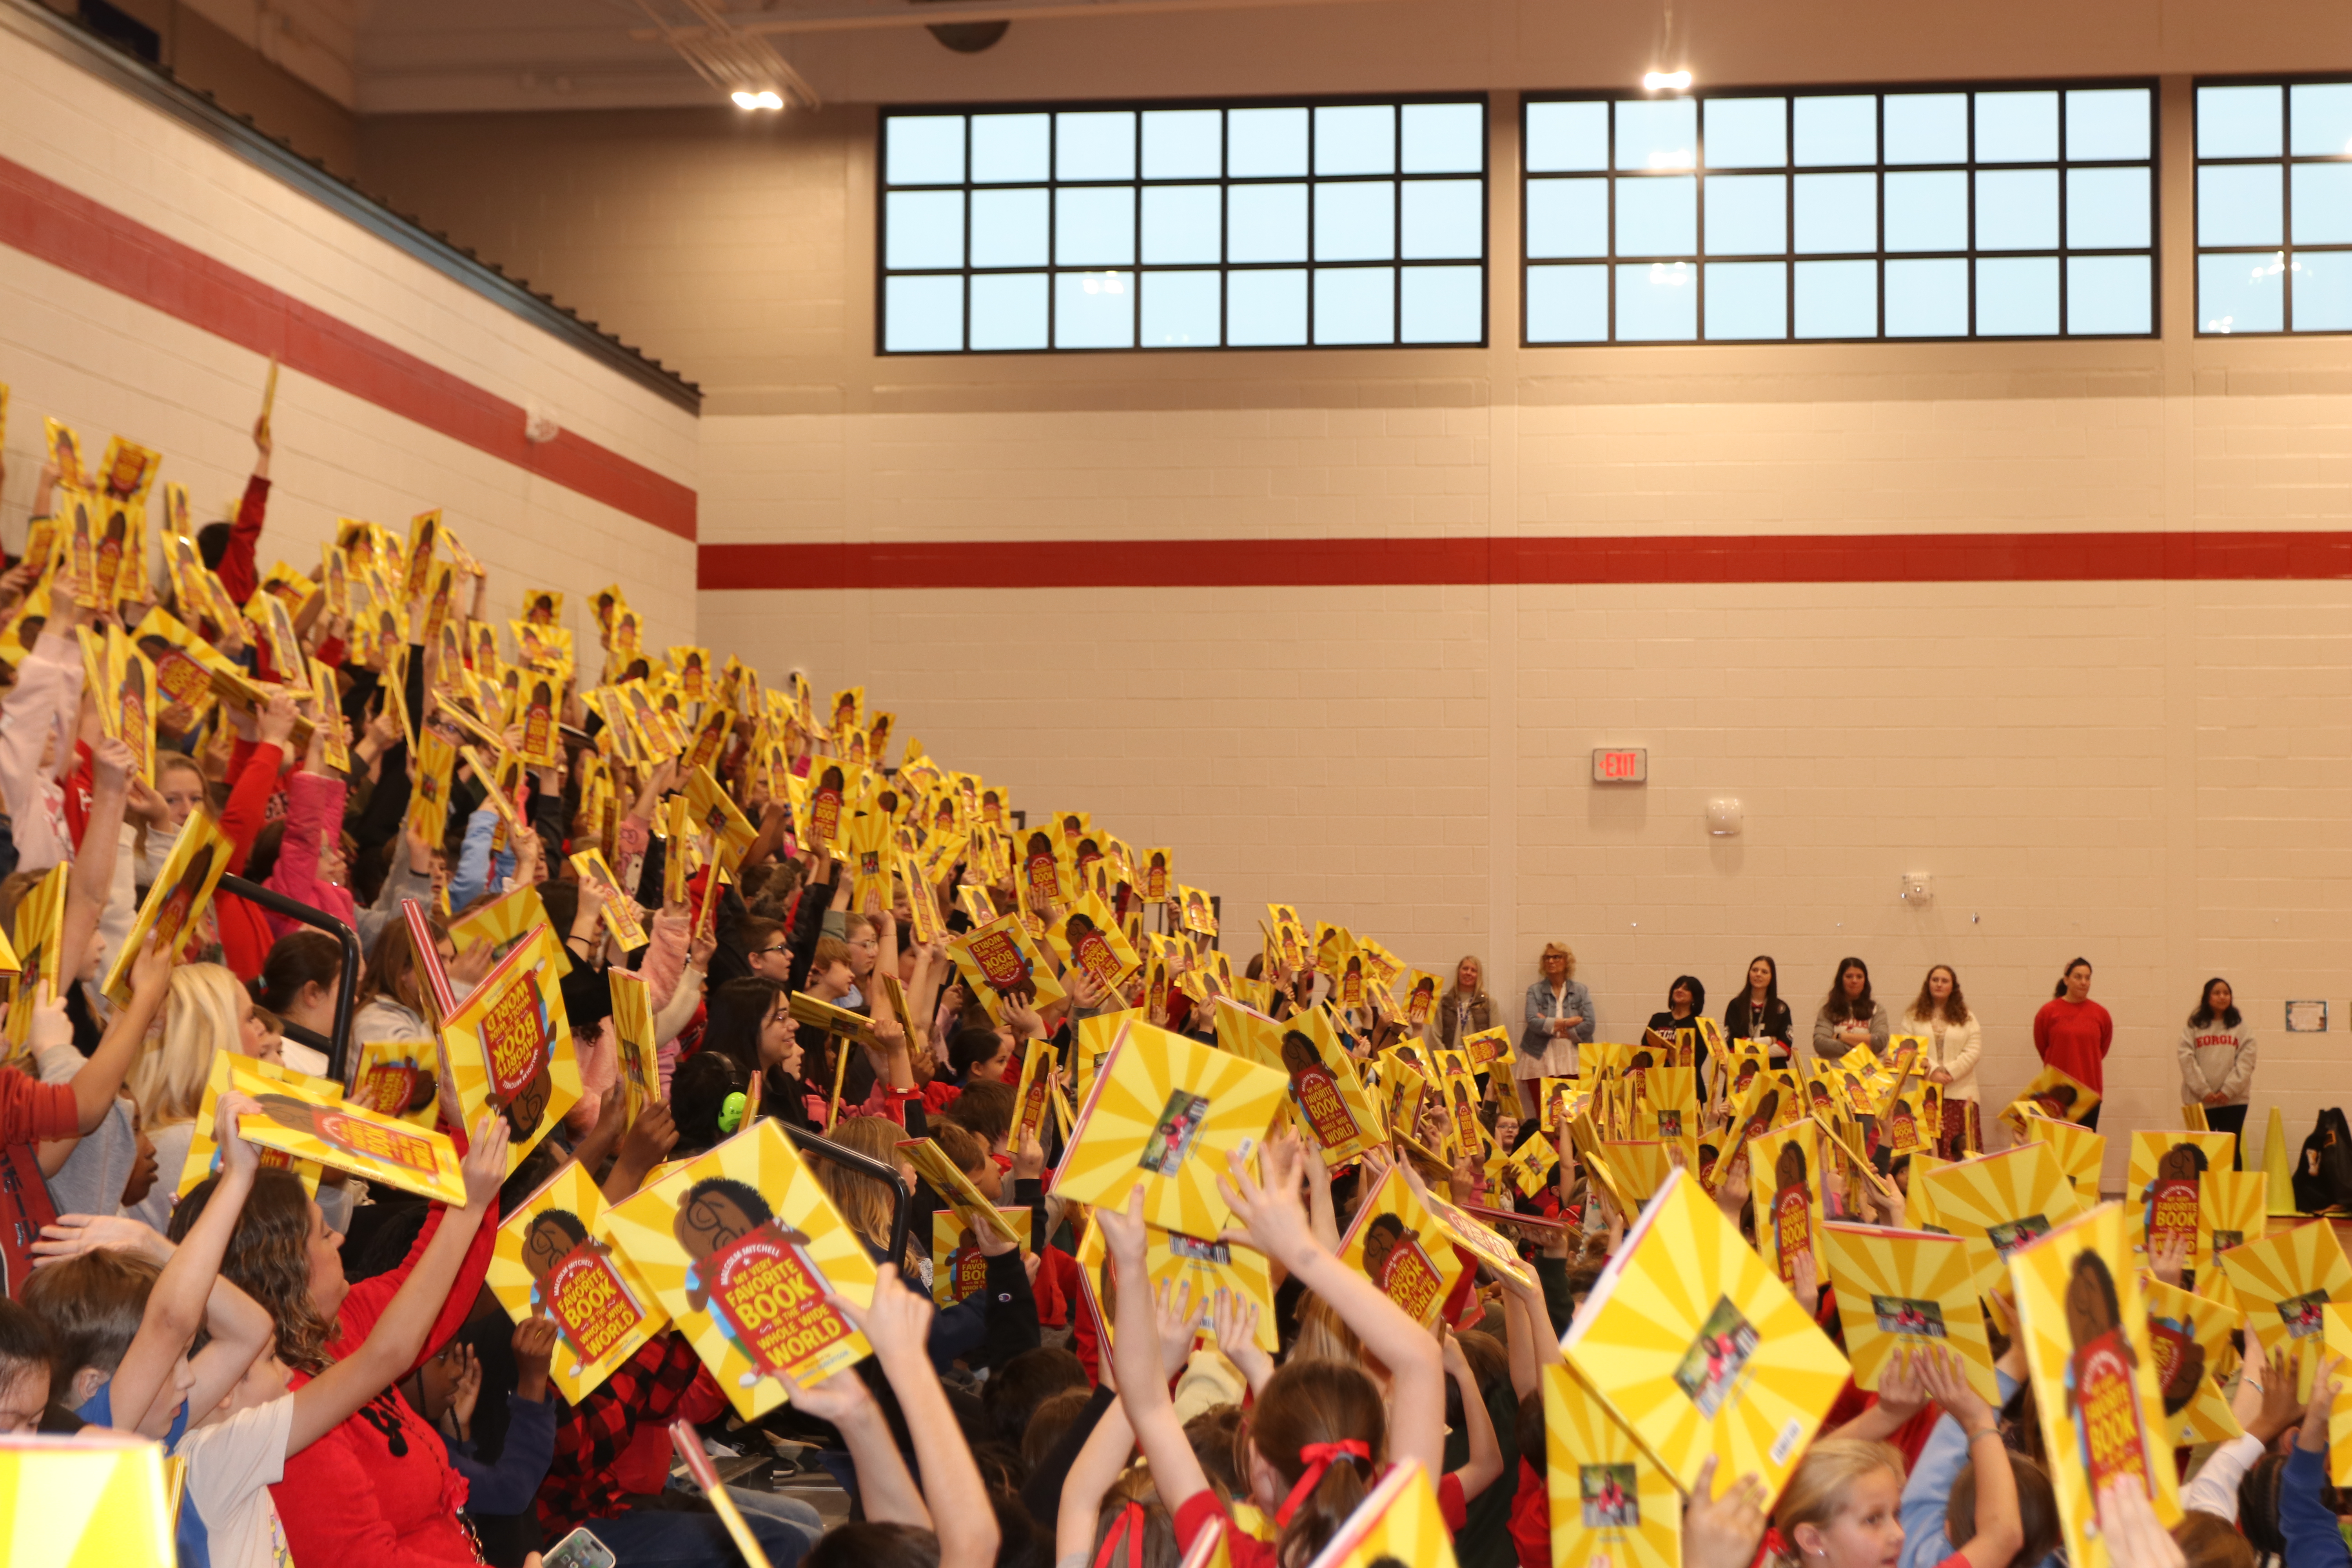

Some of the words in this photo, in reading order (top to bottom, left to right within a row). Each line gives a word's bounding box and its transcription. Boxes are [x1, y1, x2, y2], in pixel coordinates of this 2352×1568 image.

[1606, 753, 1637, 777] EXIT
[1033, 871, 1054, 884] BOOK
[973, 934, 1004, 952] WORLD
[977, 949, 989, 958] WIDE
[990, 942, 1007, 951] WHOLE
[1082, 942, 1104, 964] FAVORITE
[982, 949, 1014, 970] BOOK
[988, 959, 1018, 976] FAVORITE
[1086, 947, 1109, 971] BOOK
[486, 980, 529, 1032] WORLD
[509, 995, 532, 1023] WHOLE
[490, 1020, 508, 1043] WIDE
[493, 1011, 537, 1069] BOOK
[504, 1024, 514, 1037] THE
[2196, 1035, 2238, 1051] EORGIA
[498, 1030, 539, 1080] FAVORITE
[522, 1049, 539, 1082] MALCOLM
[523, 1050, 532, 1063] MY
[509, 1061, 523, 1079] VERY
[502, 1078, 523, 1089] MITCHELL
[1301, 1076, 1310, 1093] MALCOLM
[1309, 1073, 1326, 1083] MITCHELL
[1313, 1082, 1323, 1091] VERY
[1304, 1085, 1334, 1105] FAVORITE
[1308, 1095, 1341, 1120] BOOK
[1320, 1121, 1337, 1132] WHOLE
[1336, 1115, 1349, 1126] WIDE
[1324, 1123, 1355, 1145] WORLD
[1461, 1120, 1473, 1131] BOOK
[1894, 1129, 1914, 1137] BOOK
[338, 1163, 350, 1172] BOOK
[379, 1176, 396, 1185] WORLD
[2157, 1202, 2198, 1211] FAVORITE
[1780, 1209, 1806, 1229] FAVORITE
[2156, 1211, 2196, 1227] BOOK
[1782, 1222, 1808, 1247] BOOK
[720, 1250, 743, 1286] MALCOLM
[742, 1244, 780, 1258] MITCHELL
[732, 1270, 748, 1285] MY
[748, 1257, 772, 1276] VERY
[962, 1270, 985, 1281] BO
[1386, 1252, 1418, 1299] FAVORITE
[554, 1267, 569, 1296] MALCOLM
[568, 1259, 593, 1270] MITCHELL
[562, 1282, 572, 1294] MY
[572, 1268, 589, 1286] VERY
[725, 1258, 799, 1308] FAVORITE
[1392, 1258, 1425, 1307] BOOK
[1417, 1273, 1431, 1294] WIDE
[557, 1267, 606, 1314] FAVORITE
[735, 1272, 816, 1330] BOOK
[564, 1277, 617, 1330] BOOK
[579, 1318, 606, 1345] WHOLE
[605, 1299, 627, 1321] WIDE
[588, 1316, 596, 1324] IN
[595, 1306, 607, 1319] THE
[772, 1316, 783, 1327] IN
[782, 1307, 800, 1321] THE
[585, 1310, 635, 1357] WORLD
[756, 1321, 799, 1350] WHOLE
[798, 1304, 830, 1327] WIDE
[765, 1317, 841, 1368] WORLD
[2089, 1409, 2138, 1461] BOOK
